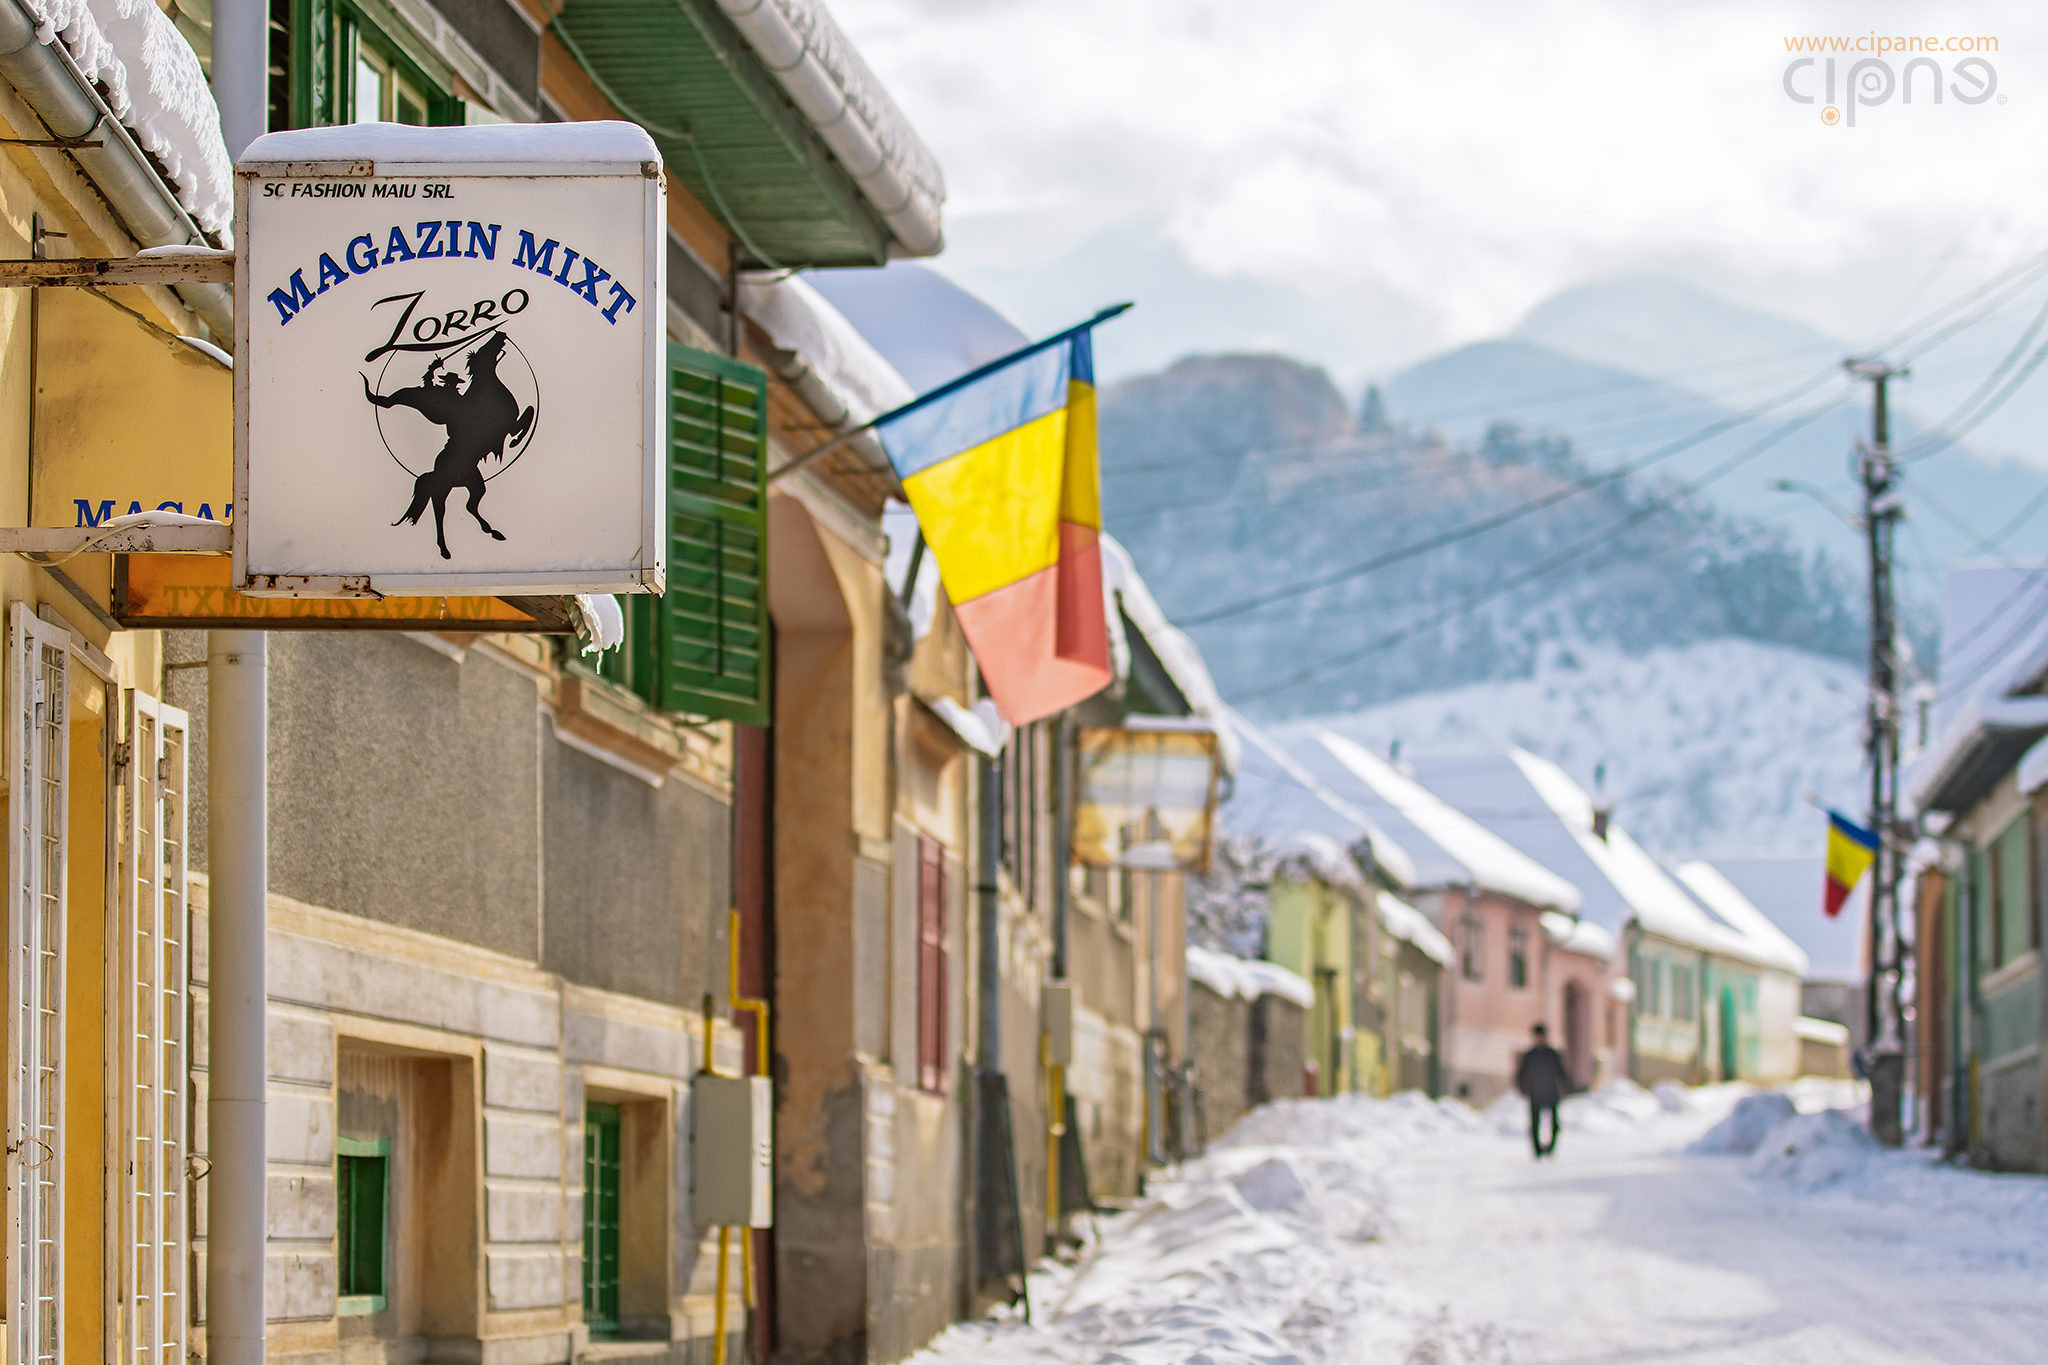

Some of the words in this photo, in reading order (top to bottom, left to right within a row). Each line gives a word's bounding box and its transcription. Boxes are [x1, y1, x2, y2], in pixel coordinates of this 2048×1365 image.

[263, 182, 286, 198] SC
[291, 183, 366, 198] FASHION
[371, 183, 417, 199] MAIU
[421, 183, 455, 199] SRL
[266, 220, 502, 327] MAGAZIN
[511, 228, 638, 326] MIXT
